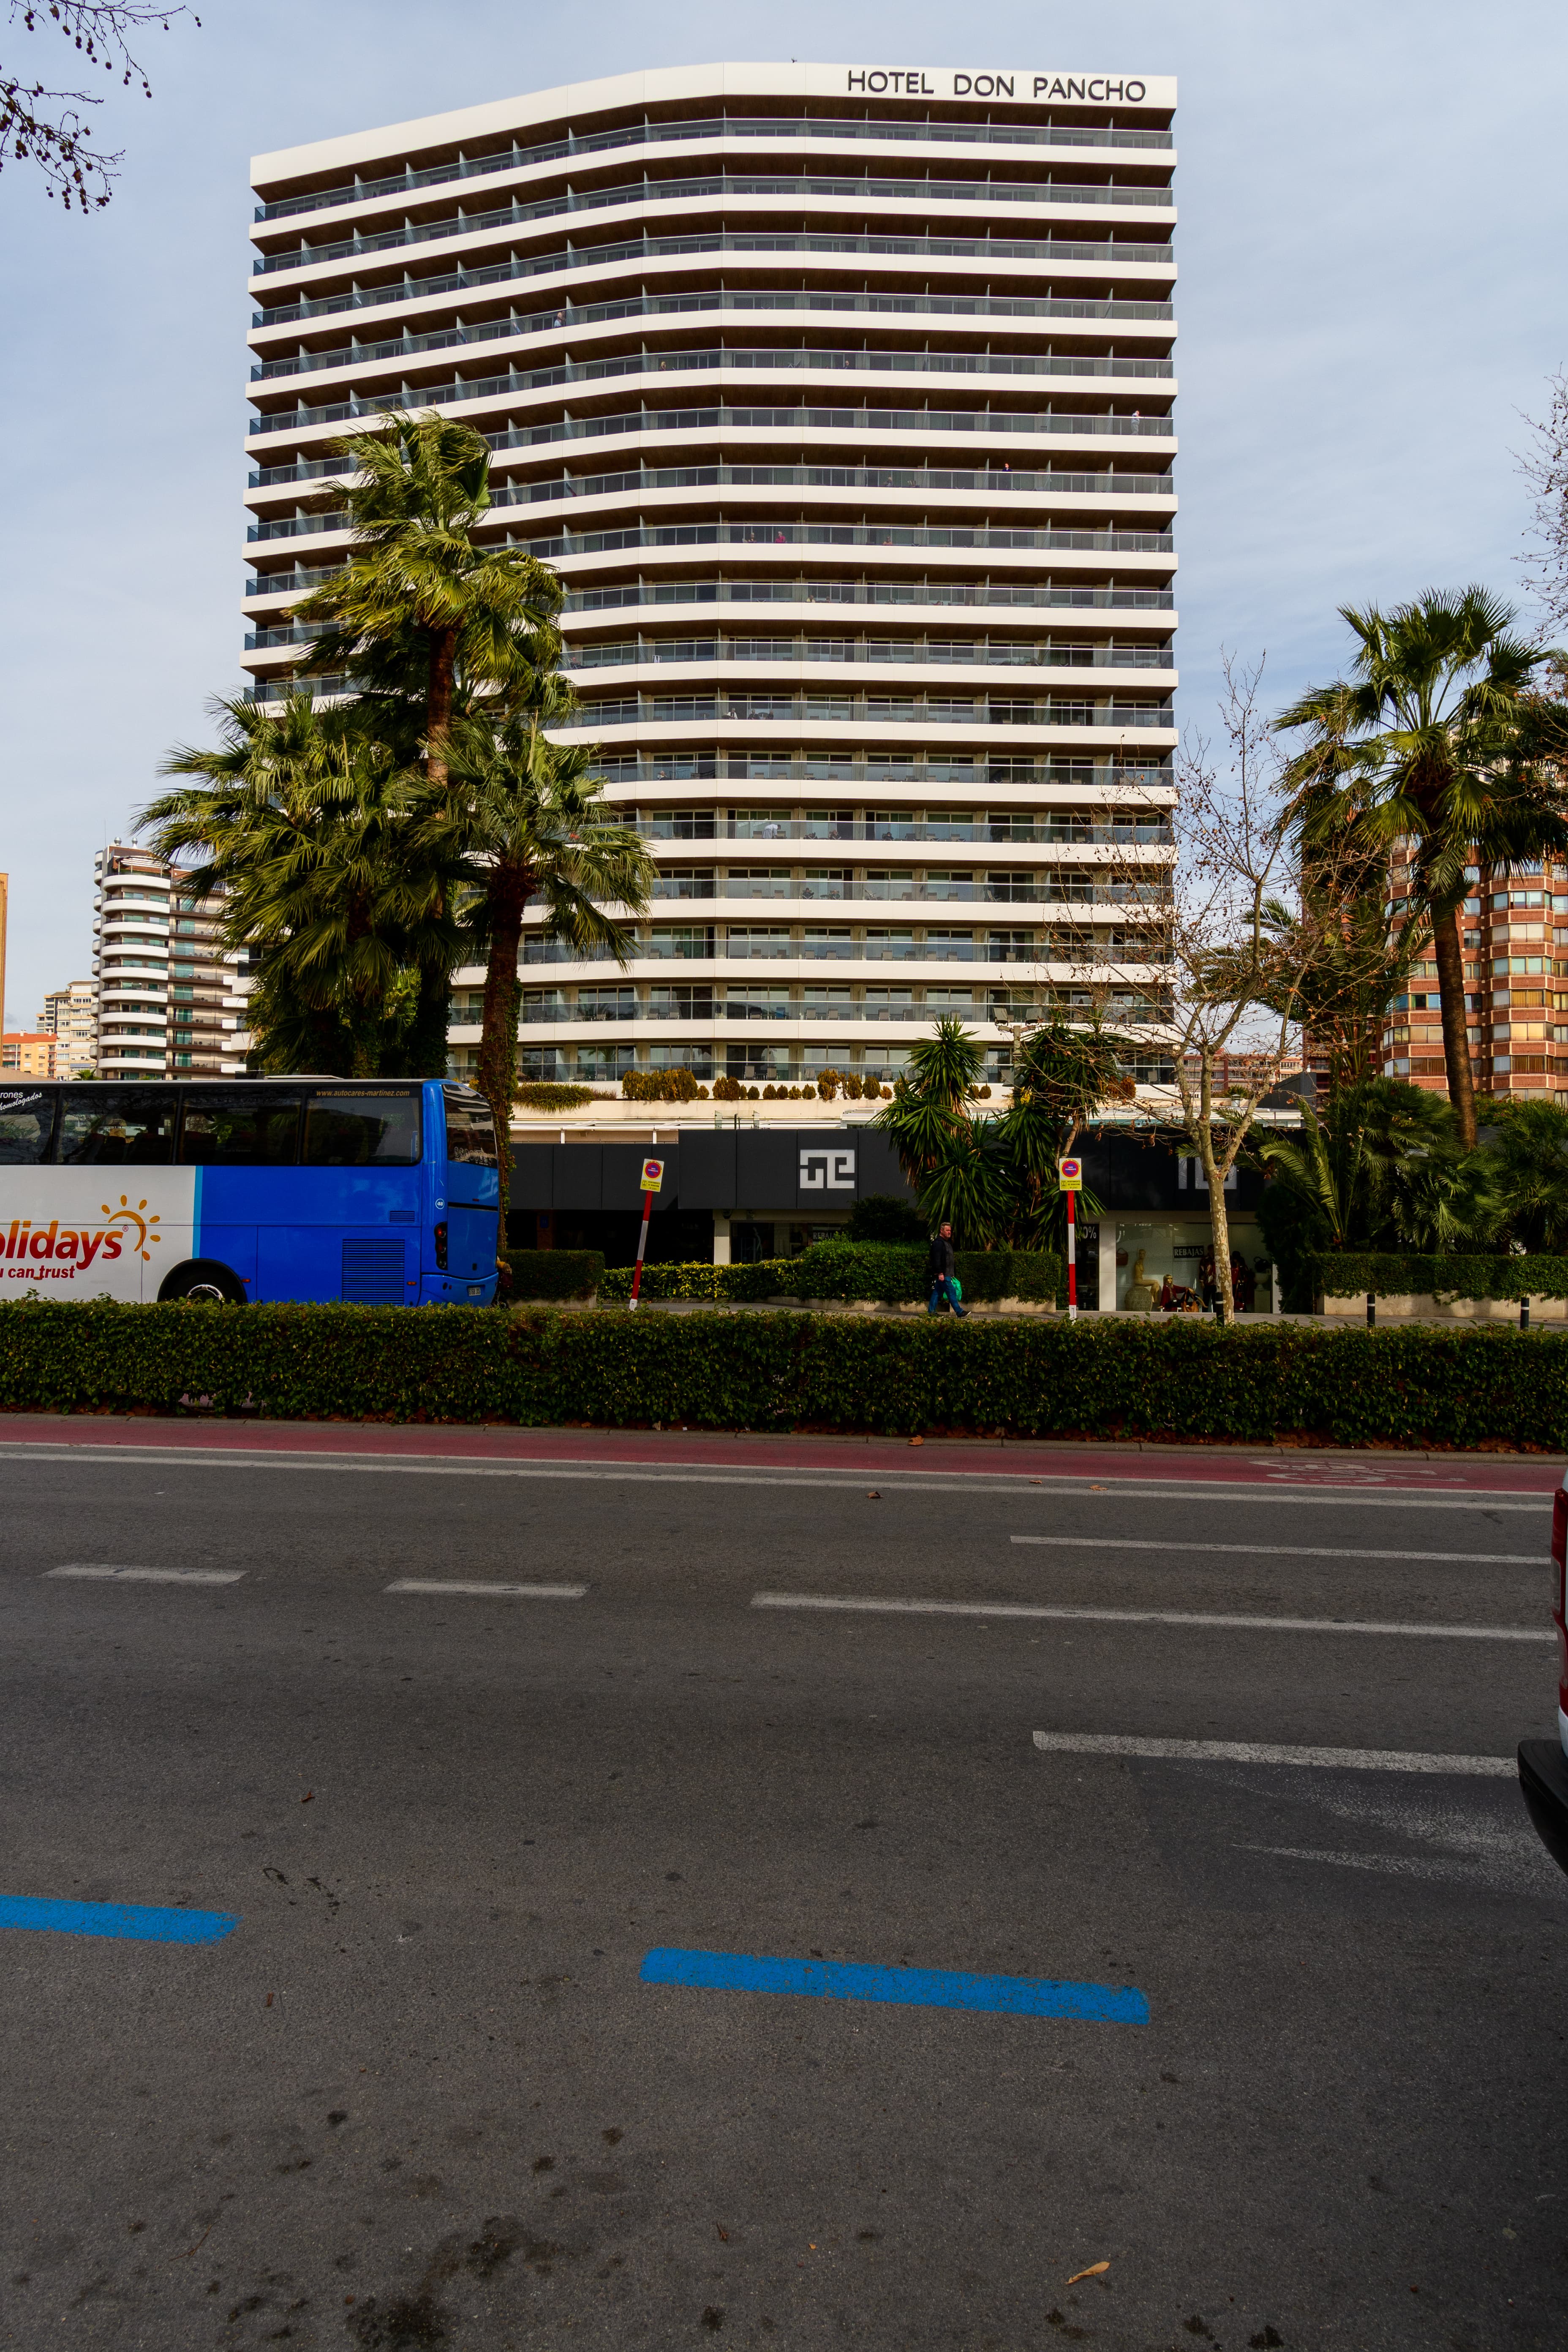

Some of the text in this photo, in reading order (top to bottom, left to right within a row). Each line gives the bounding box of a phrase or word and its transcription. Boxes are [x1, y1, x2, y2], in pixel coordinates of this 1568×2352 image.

[848, 70, 1146, 102] HOTEL DON PANCHO
[1080, 1226, 1097, 1239] 0%
[1174, 1248, 1204, 1257] REBAJAS
[8, 1268, 35, 1278] can
[39, 1265, 75, 1279] trust
